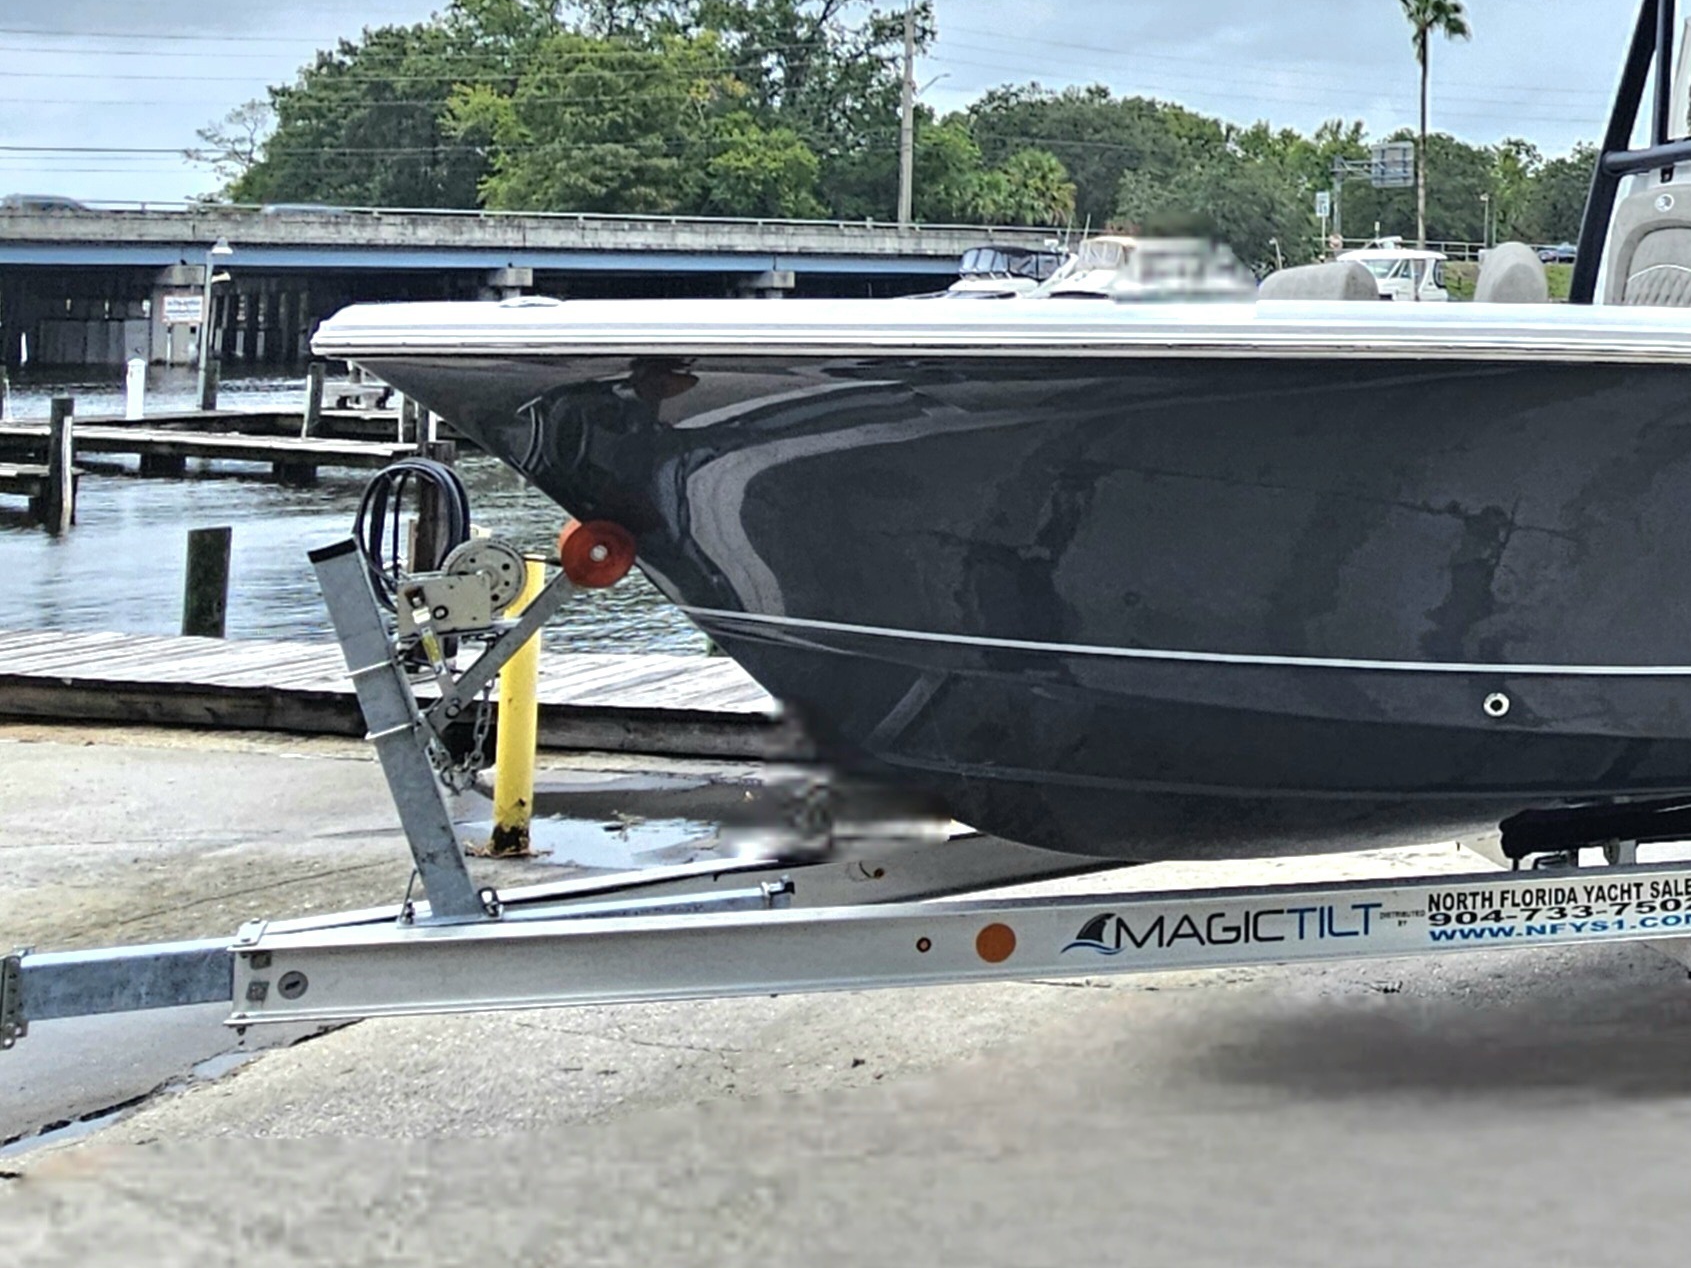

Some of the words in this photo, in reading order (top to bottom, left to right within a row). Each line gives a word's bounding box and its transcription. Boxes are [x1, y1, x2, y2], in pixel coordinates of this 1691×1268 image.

[1428, 890, 1494, 913] NORTH
[1500, 886, 1579, 909] FLORIDA
[1583, 882, 1644, 904] YACHT
[1114, 903, 1383, 949] MAGICTILT
